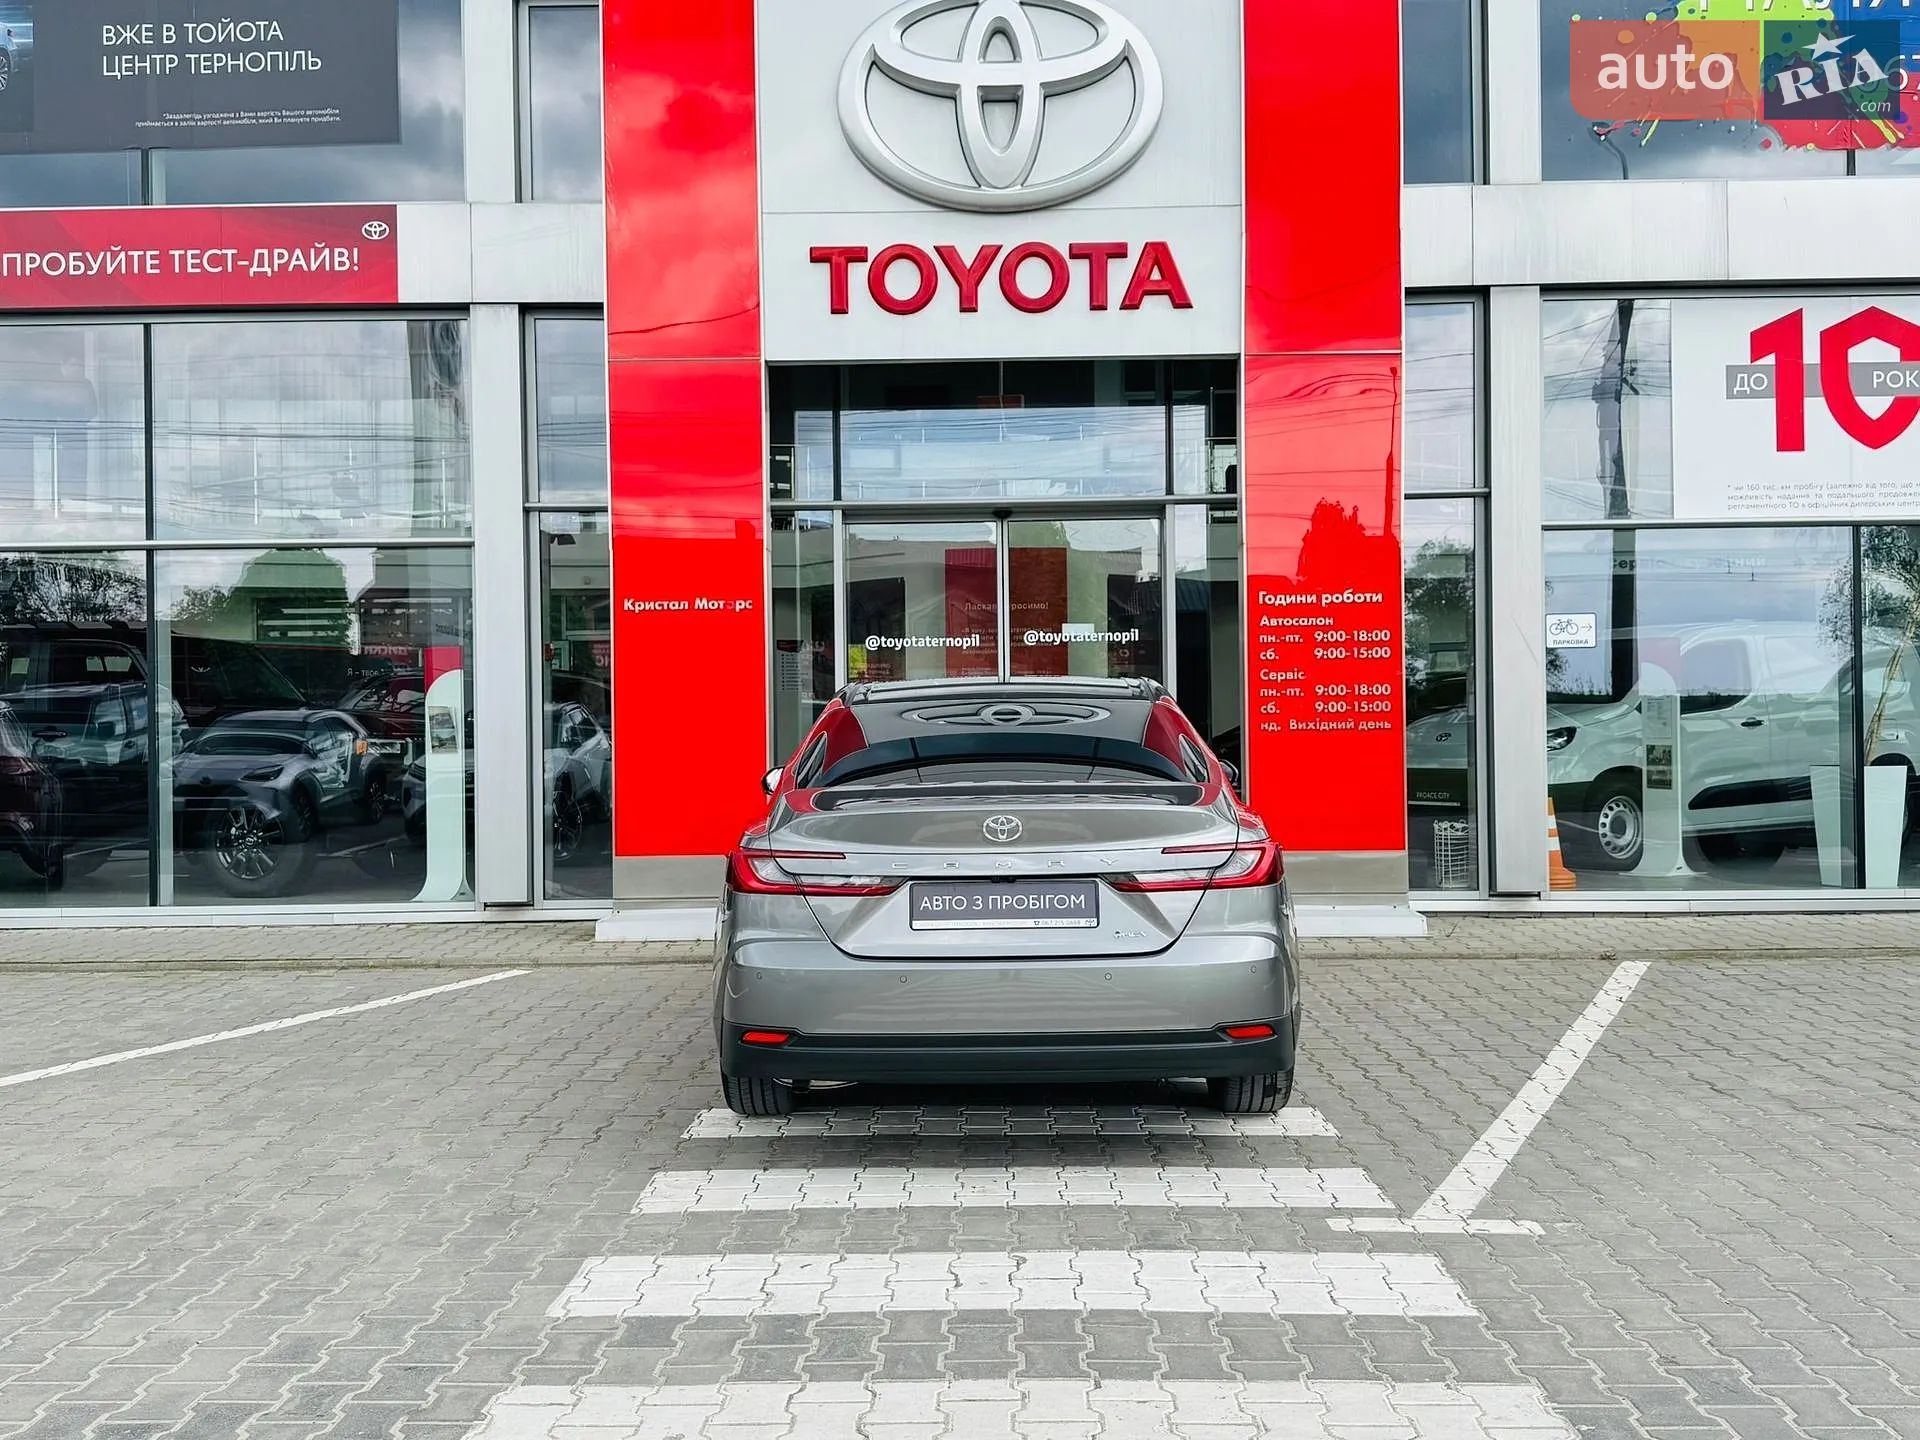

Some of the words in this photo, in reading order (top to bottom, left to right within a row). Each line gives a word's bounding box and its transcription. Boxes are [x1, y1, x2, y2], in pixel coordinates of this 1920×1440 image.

[102, 24, 154, 46] ВЖЕ
[162, 23, 177, 44] В
[183, 17, 284, 44] ТОЙОТА
[102, 54, 179, 80] ЦЕНТР
[185, 50, 322, 75] ТЕРНОПІЛЬ
[2, 246, 161, 276] ПРОБУЙТЕ
[169, 242, 360, 277] ТЕСТ-ДРАЙВ!
[809, 241, 1193, 316] TOYOTA
[1733, 373, 1769, 395] ДО
[1750, 305, 1920, 452] 10
[1789, 501, 1800, 509] ТО
[623, 598, 689, 613] Кристал
[1258, 591, 1317, 606] Години
[1321, 588, 1383, 607] роботи
[1011, 602, 1049, 611] росимо!
[1259, 615, 1334, 627] Автосалон
[865, 634, 980, 651] @toyotaternopil
[1023, 628, 1139, 646] @toyotaternopil
[1259, 633, 1304, 643] пн.-пт.
[1313, 629, 1391, 643] 9:00-18:00
[1259, 648, 1280, 660] сб.
[1313, 646, 1392, 660] 9:00-15:00
[1259, 667, 1306, 683] Сервіс
[1259, 687, 1305, 697] пн.-пт.
[1314, 683, 1392, 697] 9:00-18:00
[1260, 701, 1281, 714] сб.
[1314, 700, 1392, 713] 9:00-15:00
[1260, 722, 1282, 732] нд.
[1289, 717, 1355, 731] Вихідний
[1358, 720, 1392, 731] день
[891, 857, 1120, 870] CAMRY
[919, 895, 968, 912] АВТО
[972, 895, 984, 911] З
[988, 893, 1086, 911] ПРОБІГОМ
